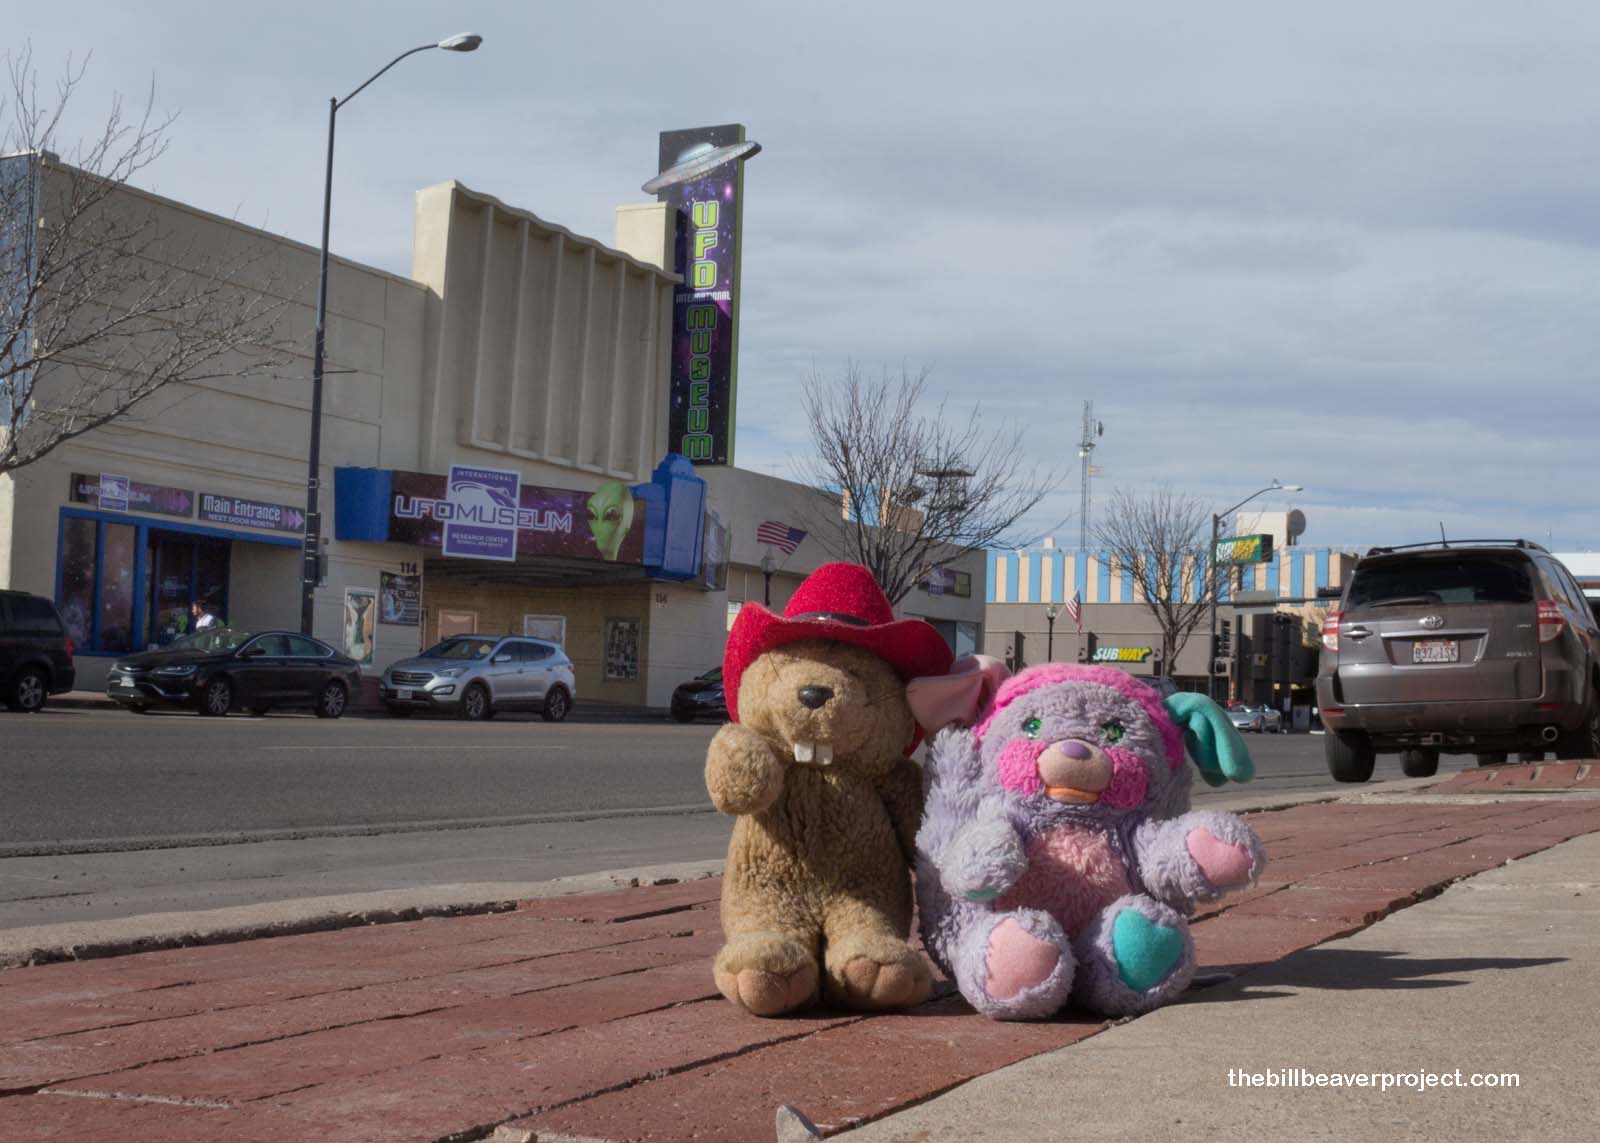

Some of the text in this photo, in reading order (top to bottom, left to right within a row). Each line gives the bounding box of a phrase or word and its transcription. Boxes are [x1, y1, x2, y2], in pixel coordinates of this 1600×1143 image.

[692, 200, 719, 290] UFO
[681, 305, 717, 460] MUSEUM
[456, 470, 513, 482] INTERNATIONAL
[203, 495, 281, 522] Main Entrance
[1216, 537, 1261, 561] SUBWAY
[400, 562, 417, 573] 114
[1093, 647, 1150, 661] SUBWAY
